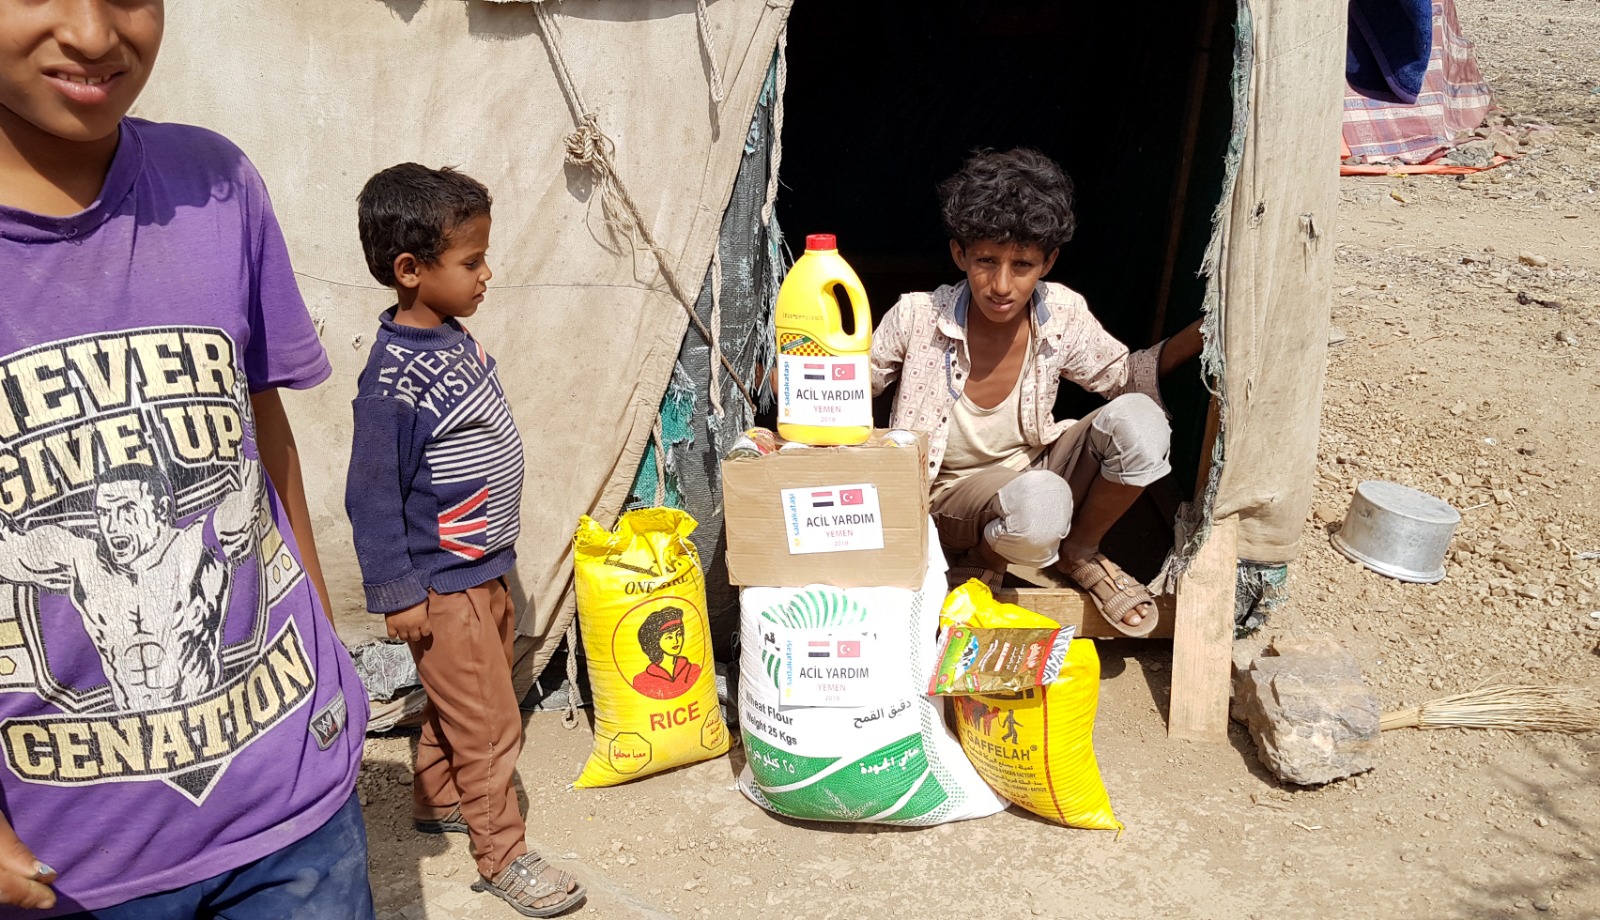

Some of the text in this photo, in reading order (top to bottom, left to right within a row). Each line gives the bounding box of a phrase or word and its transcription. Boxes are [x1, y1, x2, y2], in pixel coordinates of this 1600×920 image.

[821, 388, 865, 401] YARDIM
[813, 404, 842, 414] YEMEN
[0, 404, 244, 515] GIVE UP
[832, 512, 875, 526] YARDIM
[825, 529, 854, 538] YEMEN
[624, 581, 656, 595] ONE
[826, 667, 870, 679] YARDIM
[818, 683, 847, 692] YEMEN
[6, 632, 312, 779] CENATION
[649, 700, 701, 732] RICE
[767, 705, 794, 726] Flour
[853, 699, 912, 729] دقيق القمح
[767, 725, 778, 738] 25
[779, 730, 798, 746] Kgs
